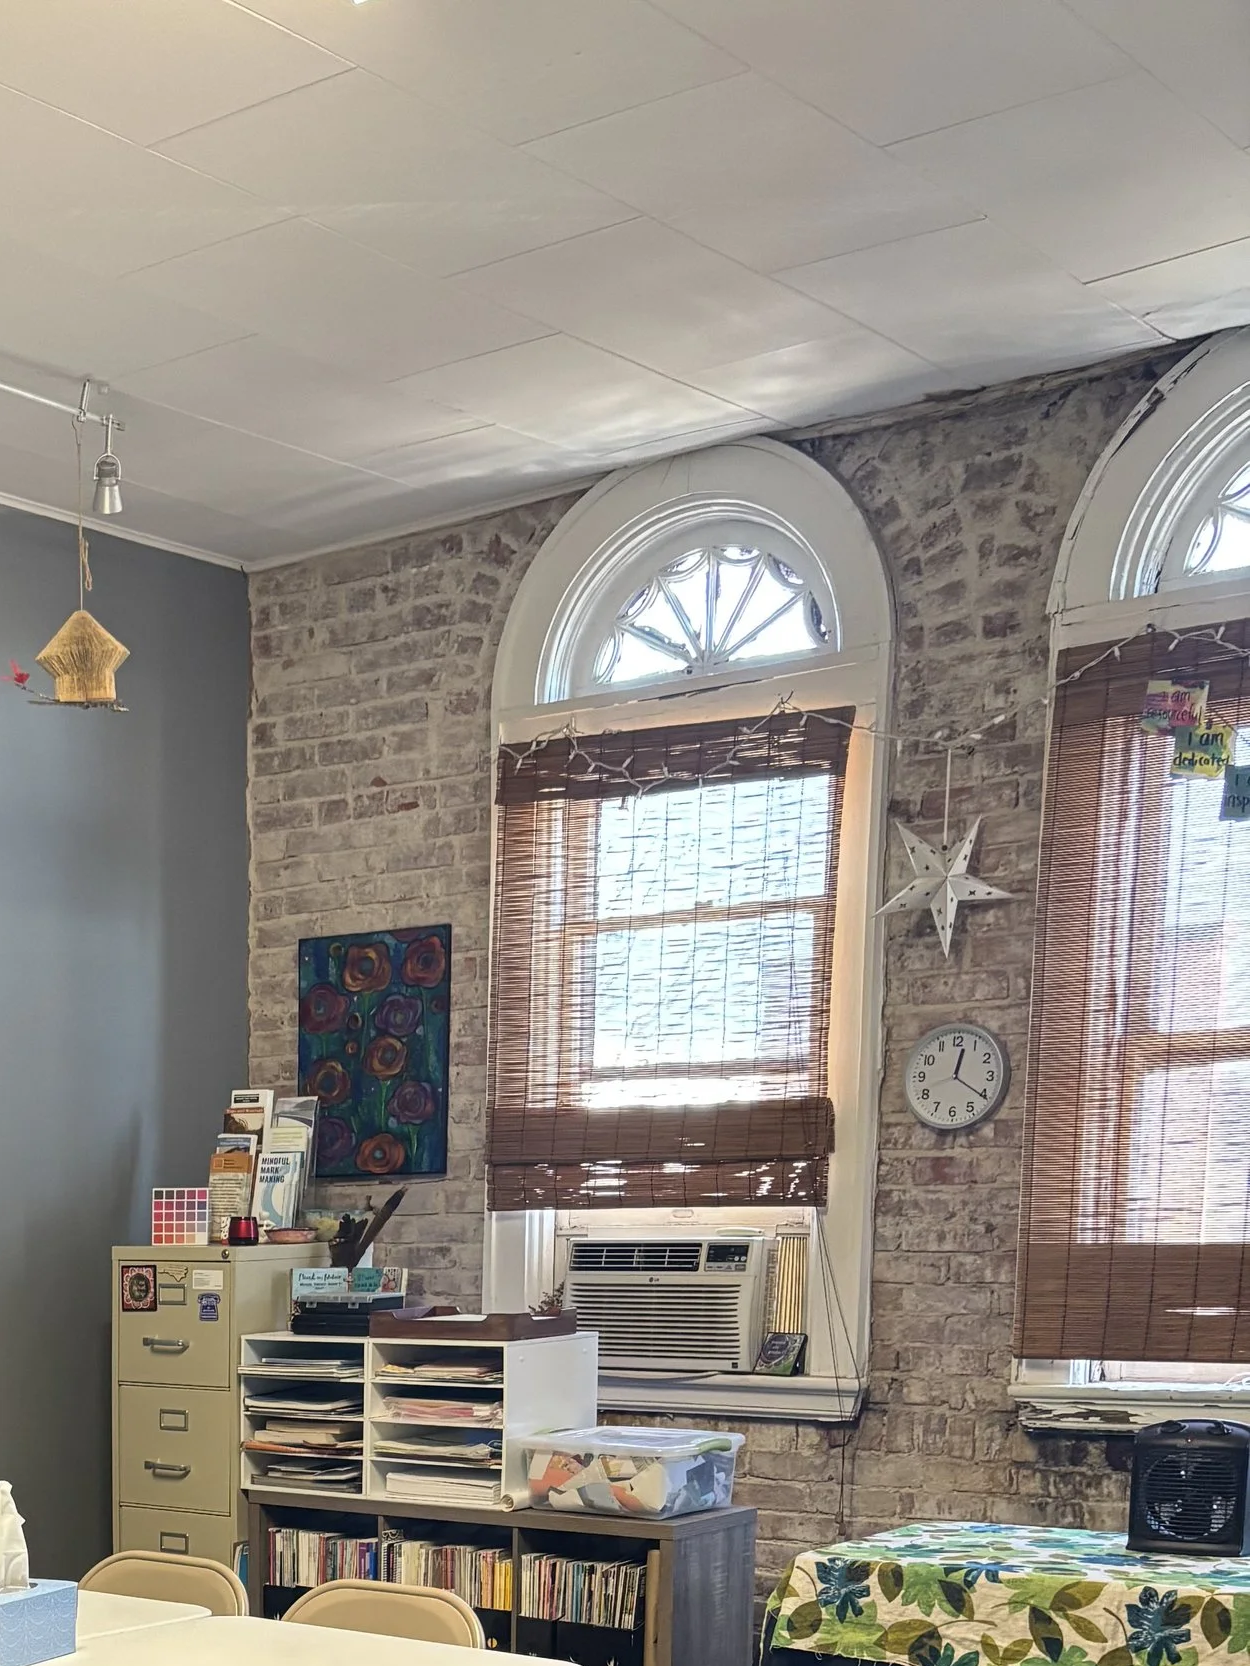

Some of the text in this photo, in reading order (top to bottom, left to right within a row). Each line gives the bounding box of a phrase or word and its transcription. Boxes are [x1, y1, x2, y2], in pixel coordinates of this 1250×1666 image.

[1172, 690, 1190, 703] am
[1188, 731, 1224, 746] I am
[1173, 751, 1230, 766] dedicated
[938, 1040, 945, 1053] 11
[952, 1035, 964, 1047] 12
[973, 1039, 977, 1052] 1
[923, 1054, 935, 1066] 10
[982, 1052, 991, 1064] 2
[917, 1071, 926, 1083] 9
[985, 1070, 995, 1082] 3
[921, 1088, 930, 1100] 8
[933, 1101, 941, 1113] 7
[948, 1105, 957, 1117] 6
[965, 1101, 975, 1113] 5
[261, 1157, 290, 1165] MINDFUL
[259, 1175, 285, 1183] MAKING
